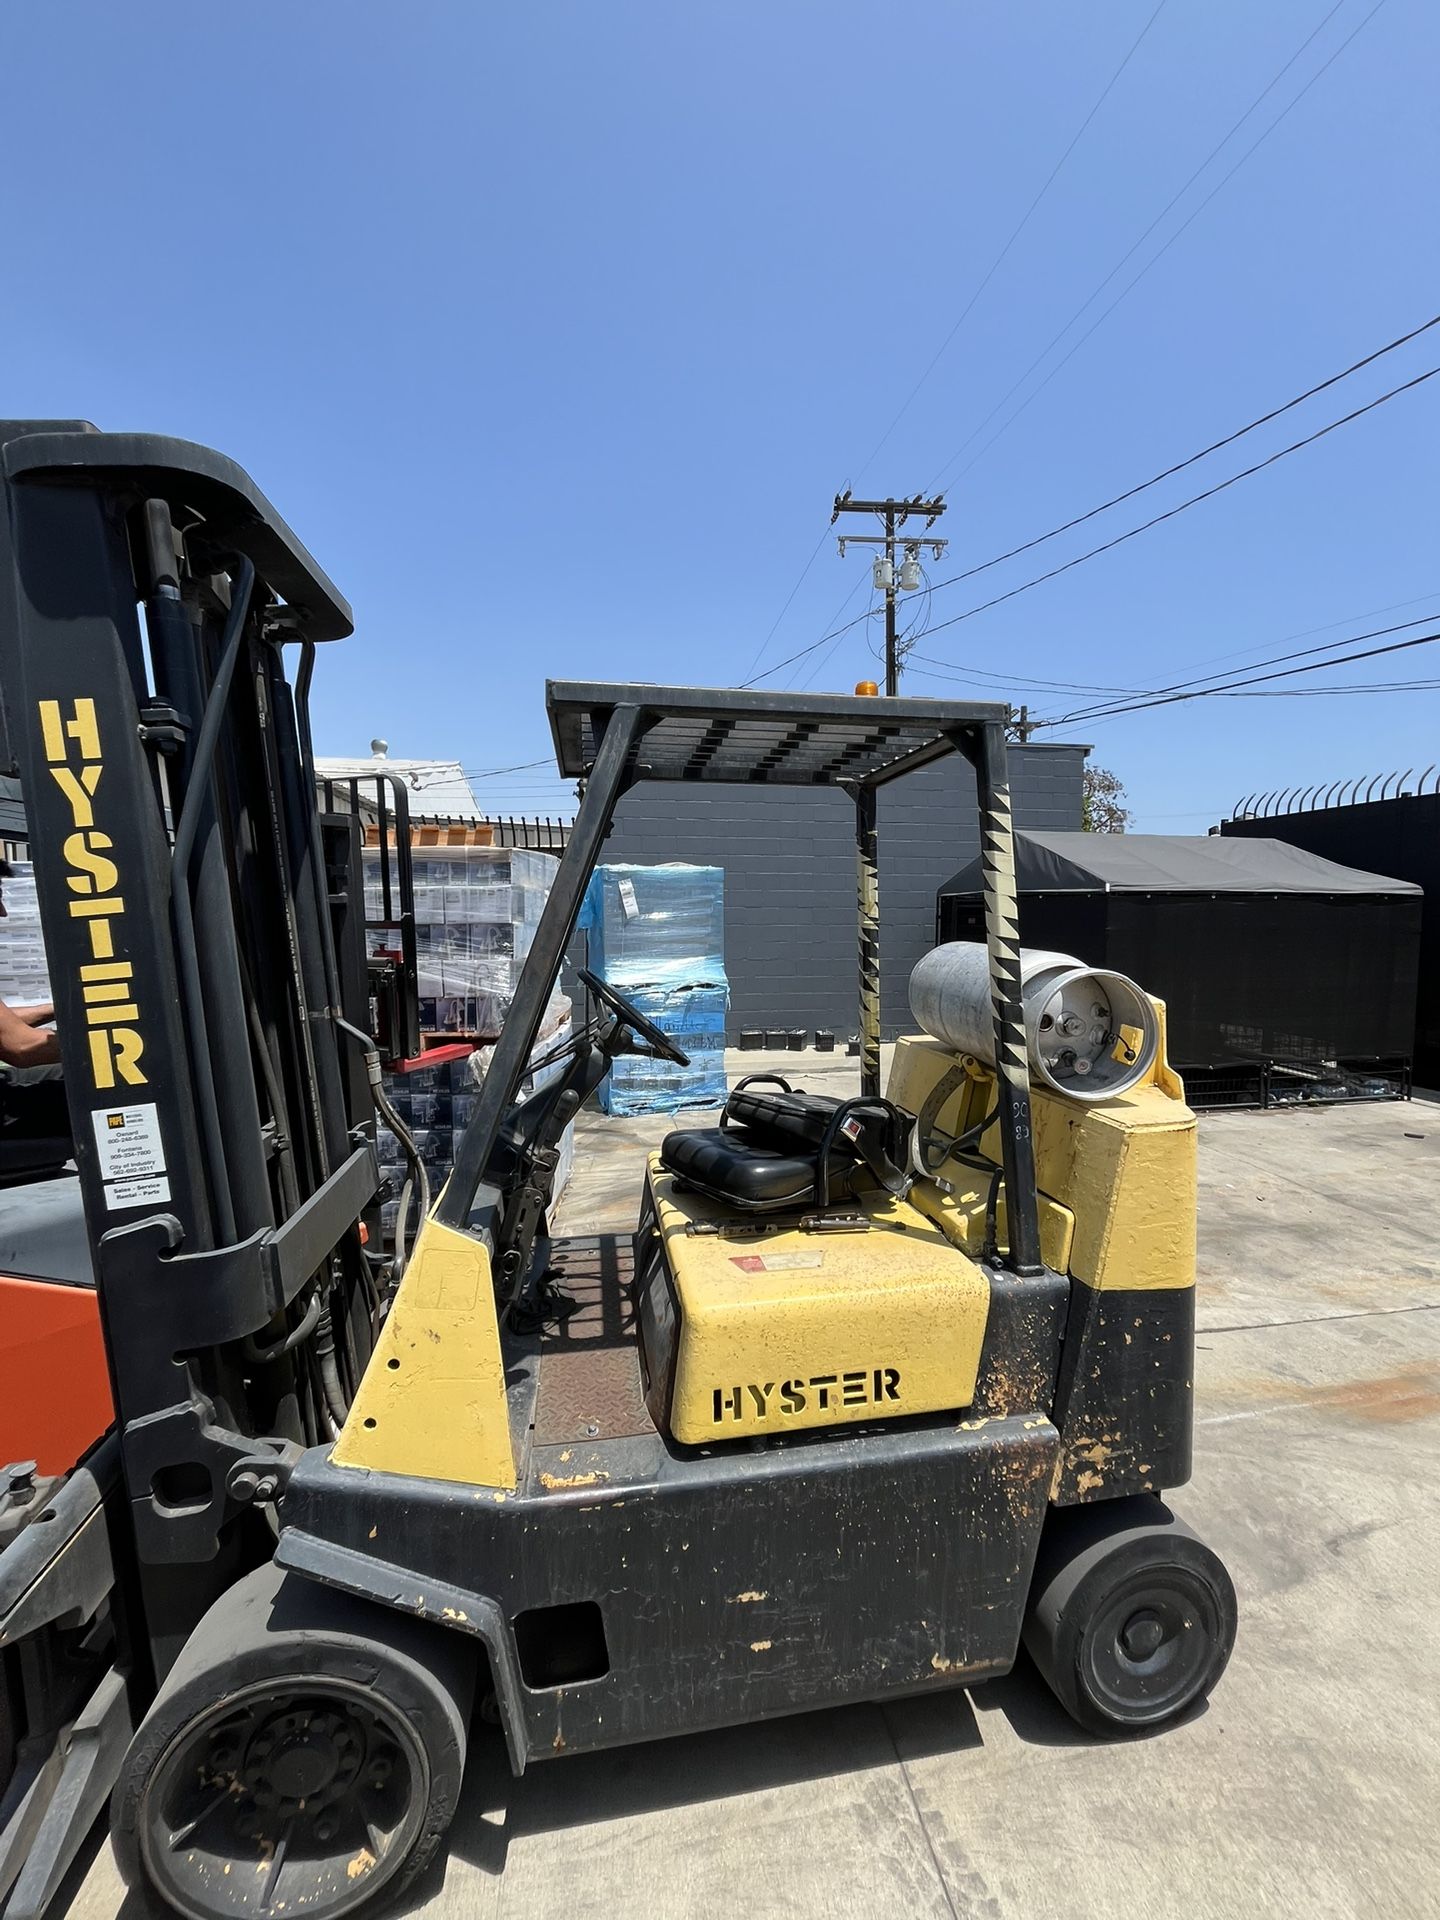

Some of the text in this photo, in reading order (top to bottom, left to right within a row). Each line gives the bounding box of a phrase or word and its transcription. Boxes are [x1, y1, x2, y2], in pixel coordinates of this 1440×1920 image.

[39, 698, 148, 1089] HYSTER
[130, 1160, 156, 1168] Industry
[137, 1182, 161, 1191] Service
[116, 1192, 138, 1200] Rental
[143, 1189, 160, 1197] Parts
[713, 1368, 901, 1423] HYSTER
